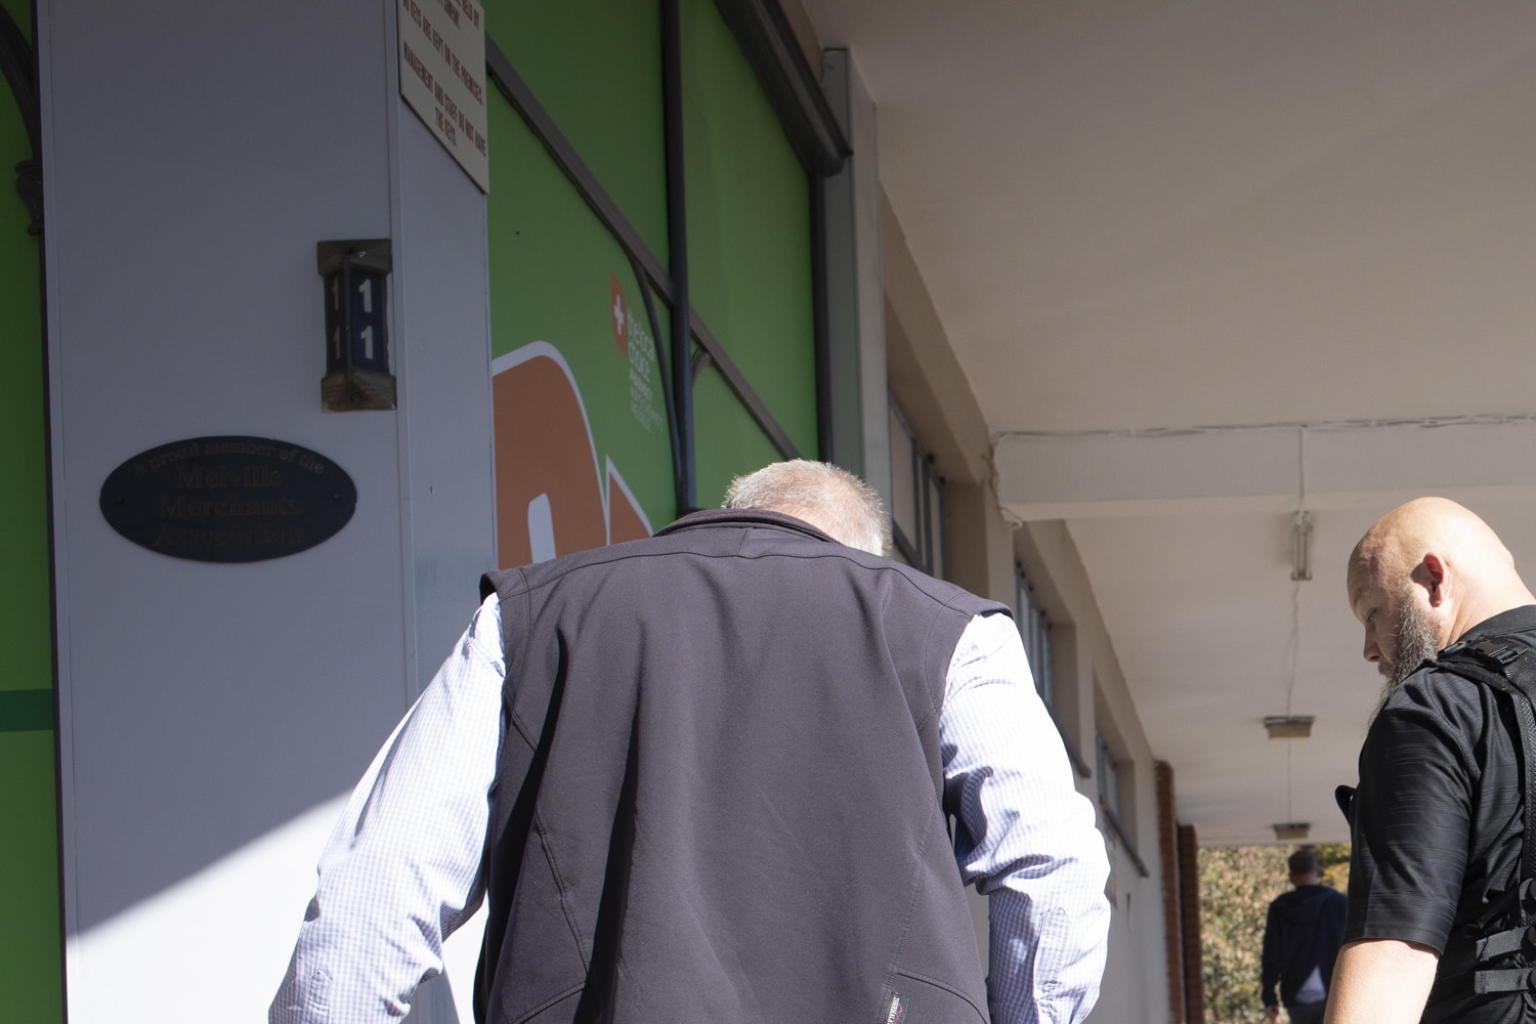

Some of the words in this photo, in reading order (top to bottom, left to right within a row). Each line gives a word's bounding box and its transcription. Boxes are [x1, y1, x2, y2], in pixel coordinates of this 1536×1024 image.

[411, 0, 422, 28] KEYS
[423, 13, 432, 41] ARE
[433, 27, 444, 56] KEPT
[445, 42, 451, 67] ON
[452, 52, 460, 79] THE
[404, 39, 433, 93] MANAGEMENT
[435, 79, 443, 106] AND
[445, 91, 457, 123] STAFF
[459, 108, 465, 132] DO
[466, 117, 474, 143] NOT
[435, 104, 444, 132] THE
[280, 447, 297, 461] of
[299, 453, 326, 475] the
[176, 464, 283, 489] Melville
